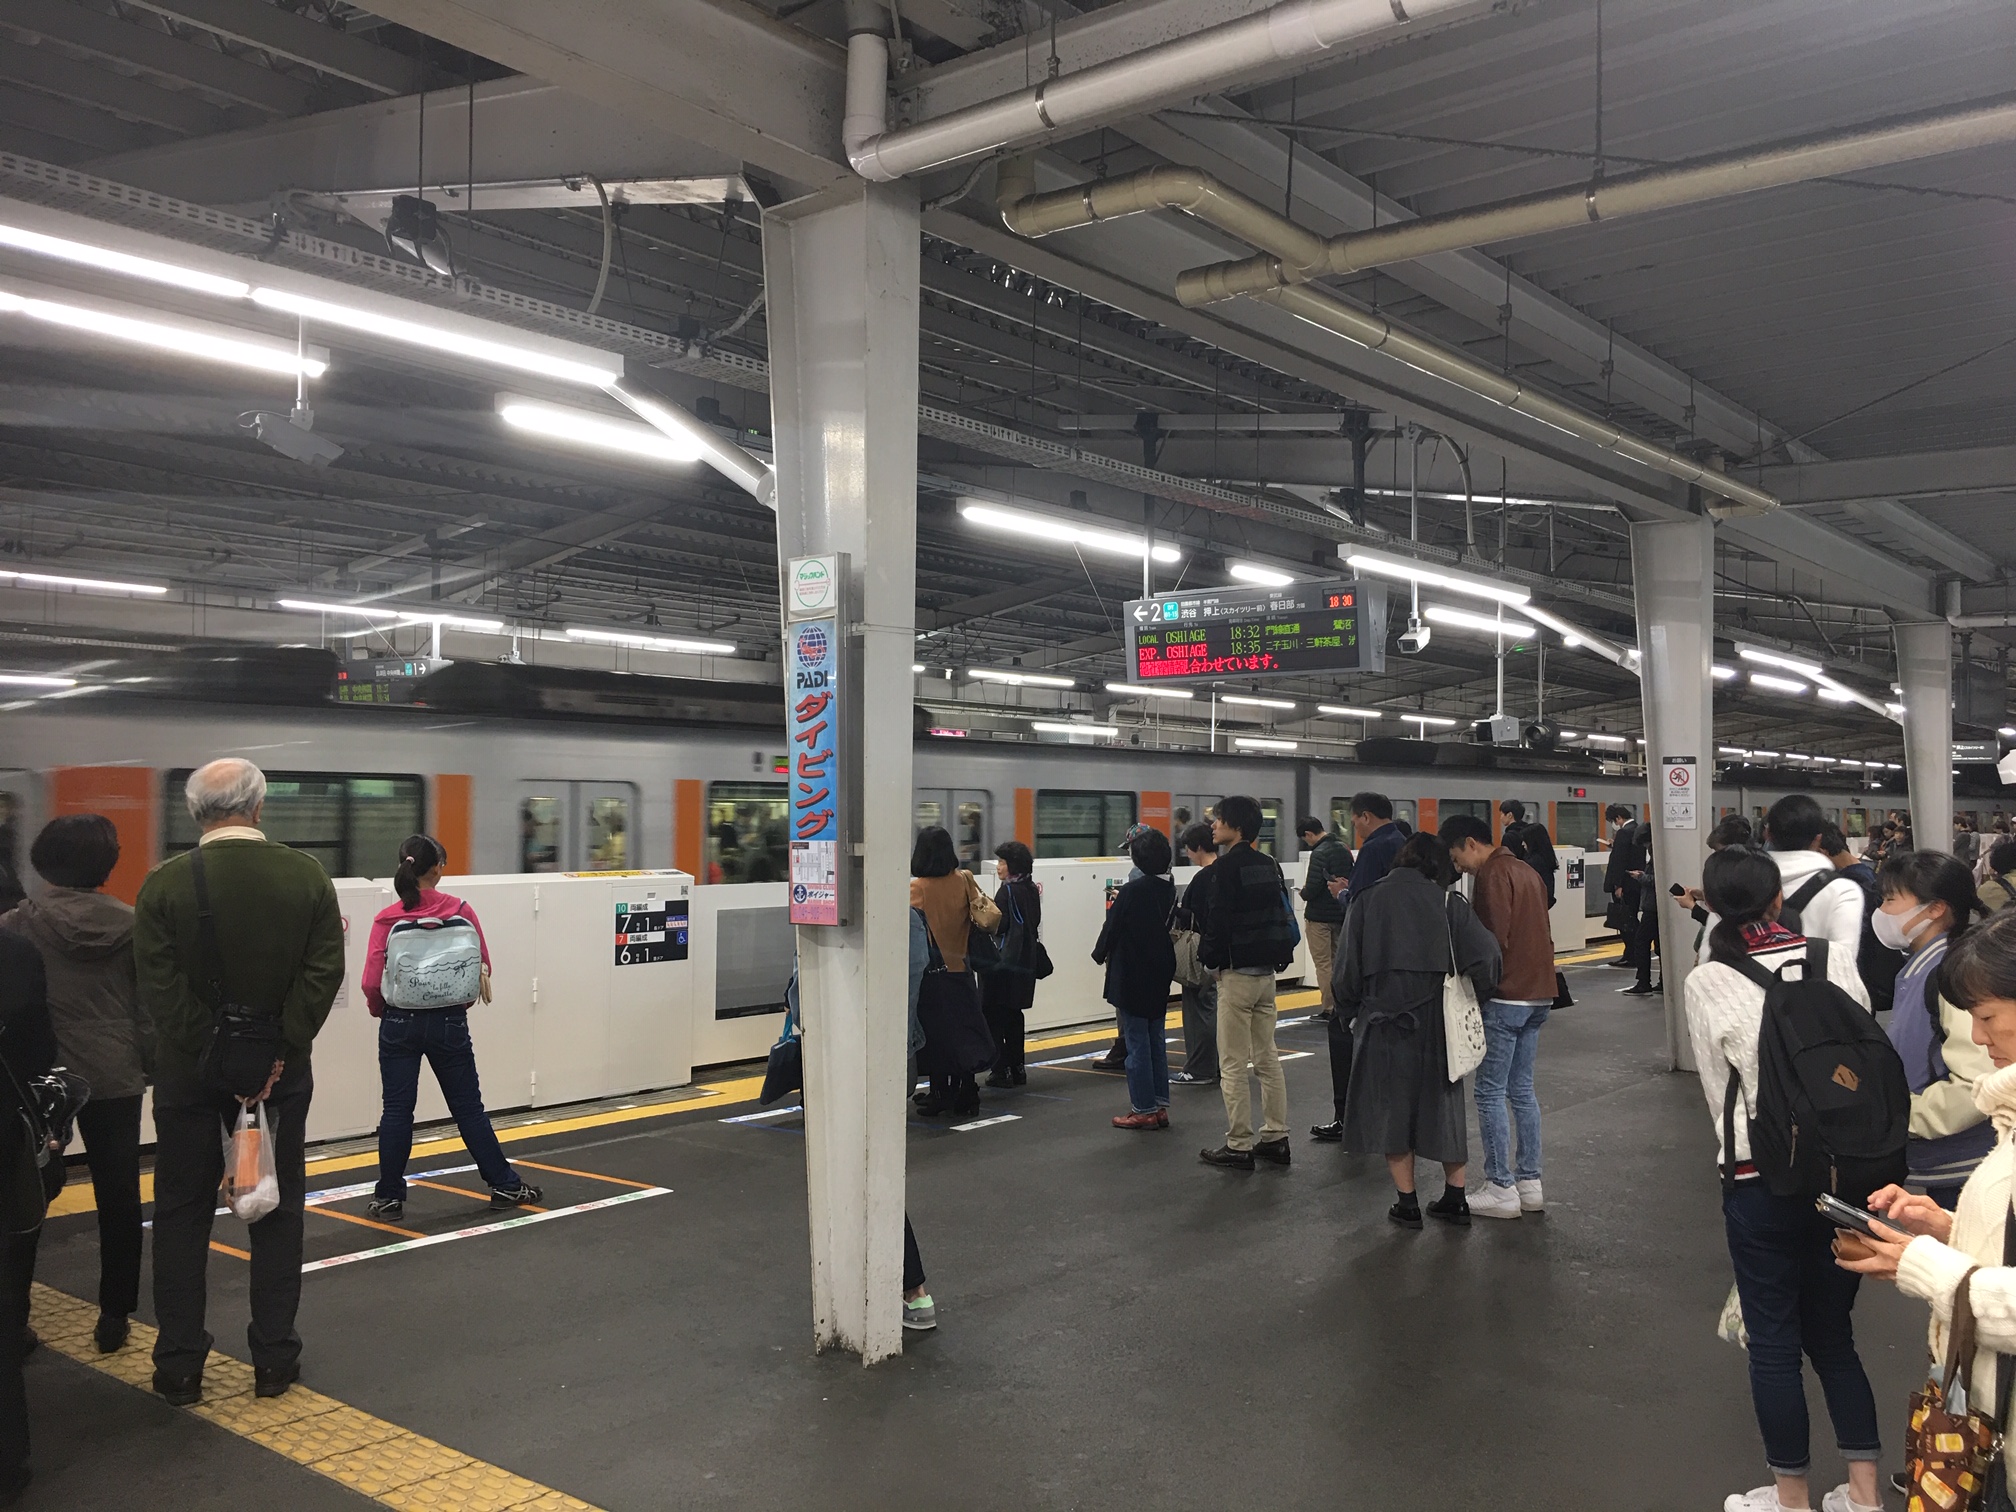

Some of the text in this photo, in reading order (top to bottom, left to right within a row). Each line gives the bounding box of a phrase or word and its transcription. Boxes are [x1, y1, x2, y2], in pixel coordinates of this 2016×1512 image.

[1150, 603, 1161, 622] 2
[1181, 608, 1197, 619] 渋谷
[1270, 600, 1295, 611] 春日部
[1139, 634, 1159, 645] LOCAL
[1165, 629, 1206, 644] OSHIAGE
[1230, 625, 1260, 640] 18:32
[1139, 647, 1160, 661] EXP.
[1166, 643, 1208, 659] OSHIAGE
[1231, 640, 1261, 655] 18:35
[796, 670, 829, 689] PADI
[795, 691, 835, 840] ダイビング
[808, 890, 835, 899] ボイジャー
[617, 904, 626, 913] 10
[621, 914, 632, 933] 7
[645, 917, 650, 931] 1
[619, 935, 624, 944] 7
[620, 945, 631, 964] 6
[645, 948, 650, 962] 1
[409, 977, 431, 988] Pour
